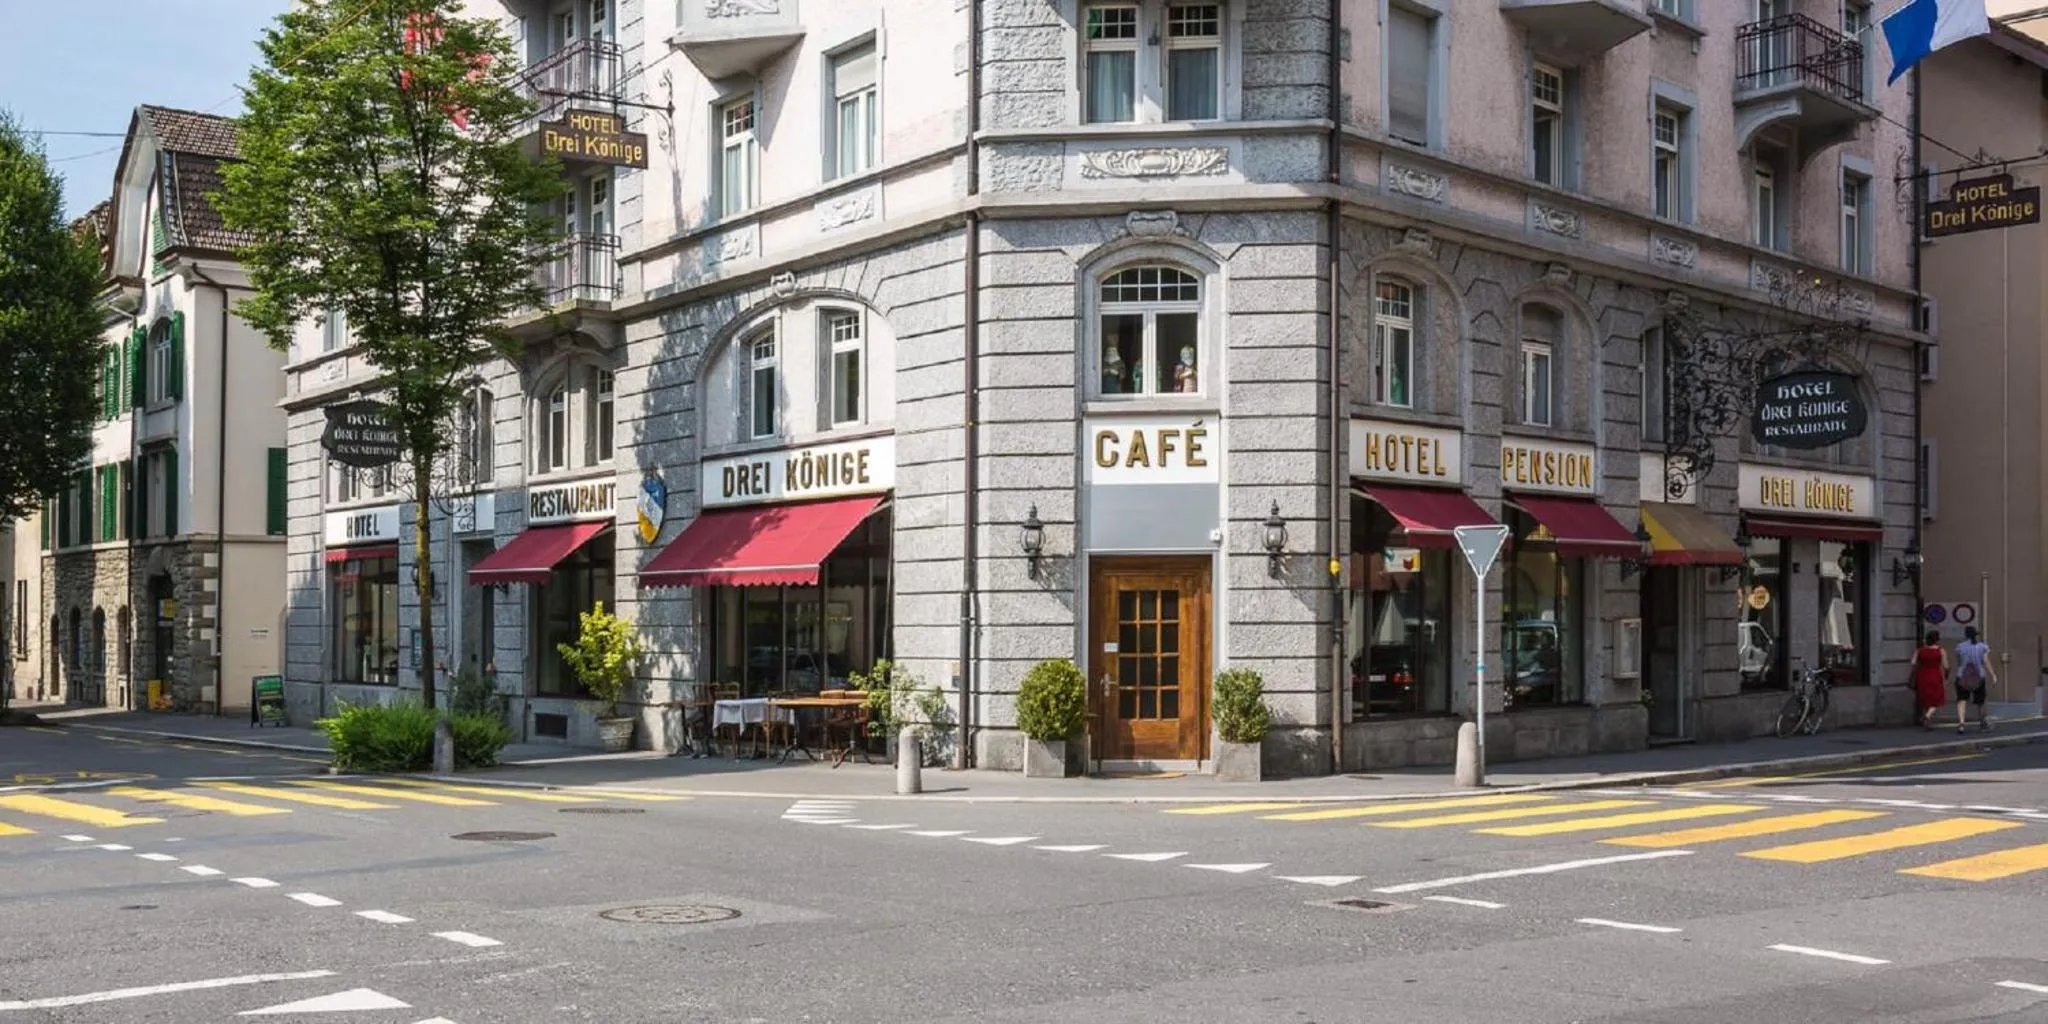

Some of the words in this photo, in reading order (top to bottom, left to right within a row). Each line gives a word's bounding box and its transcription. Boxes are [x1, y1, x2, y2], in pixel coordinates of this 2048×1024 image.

[570, 114, 619, 134] HOTEL
[545, 131, 579, 153] Drei
[585, 136, 642, 164] Könige
[1956, 183, 2008, 203] HOTEL
[1931, 208, 1965, 229] Drei
[1972, 201, 2034, 222] Könige
[1778, 381, 1835, 399] HOTEL
[1761, 403, 1792, 421] DREI
[1096, 416, 1207, 467] CAFÉ
[1765, 421, 1847, 437] RESTAURANT
[1366, 431, 1447, 476] HOTEL
[1503, 447, 1590, 488] PENSION
[722, 461, 770, 498] DREI
[786, 449, 870, 491] KÖNIGE
[530, 482, 616, 518] RESTAURANT
[1761, 475, 1796, 507] DREI
[1804, 474, 1855, 512] KÖNIGE
[346, 513, 380, 538] HOTEL
